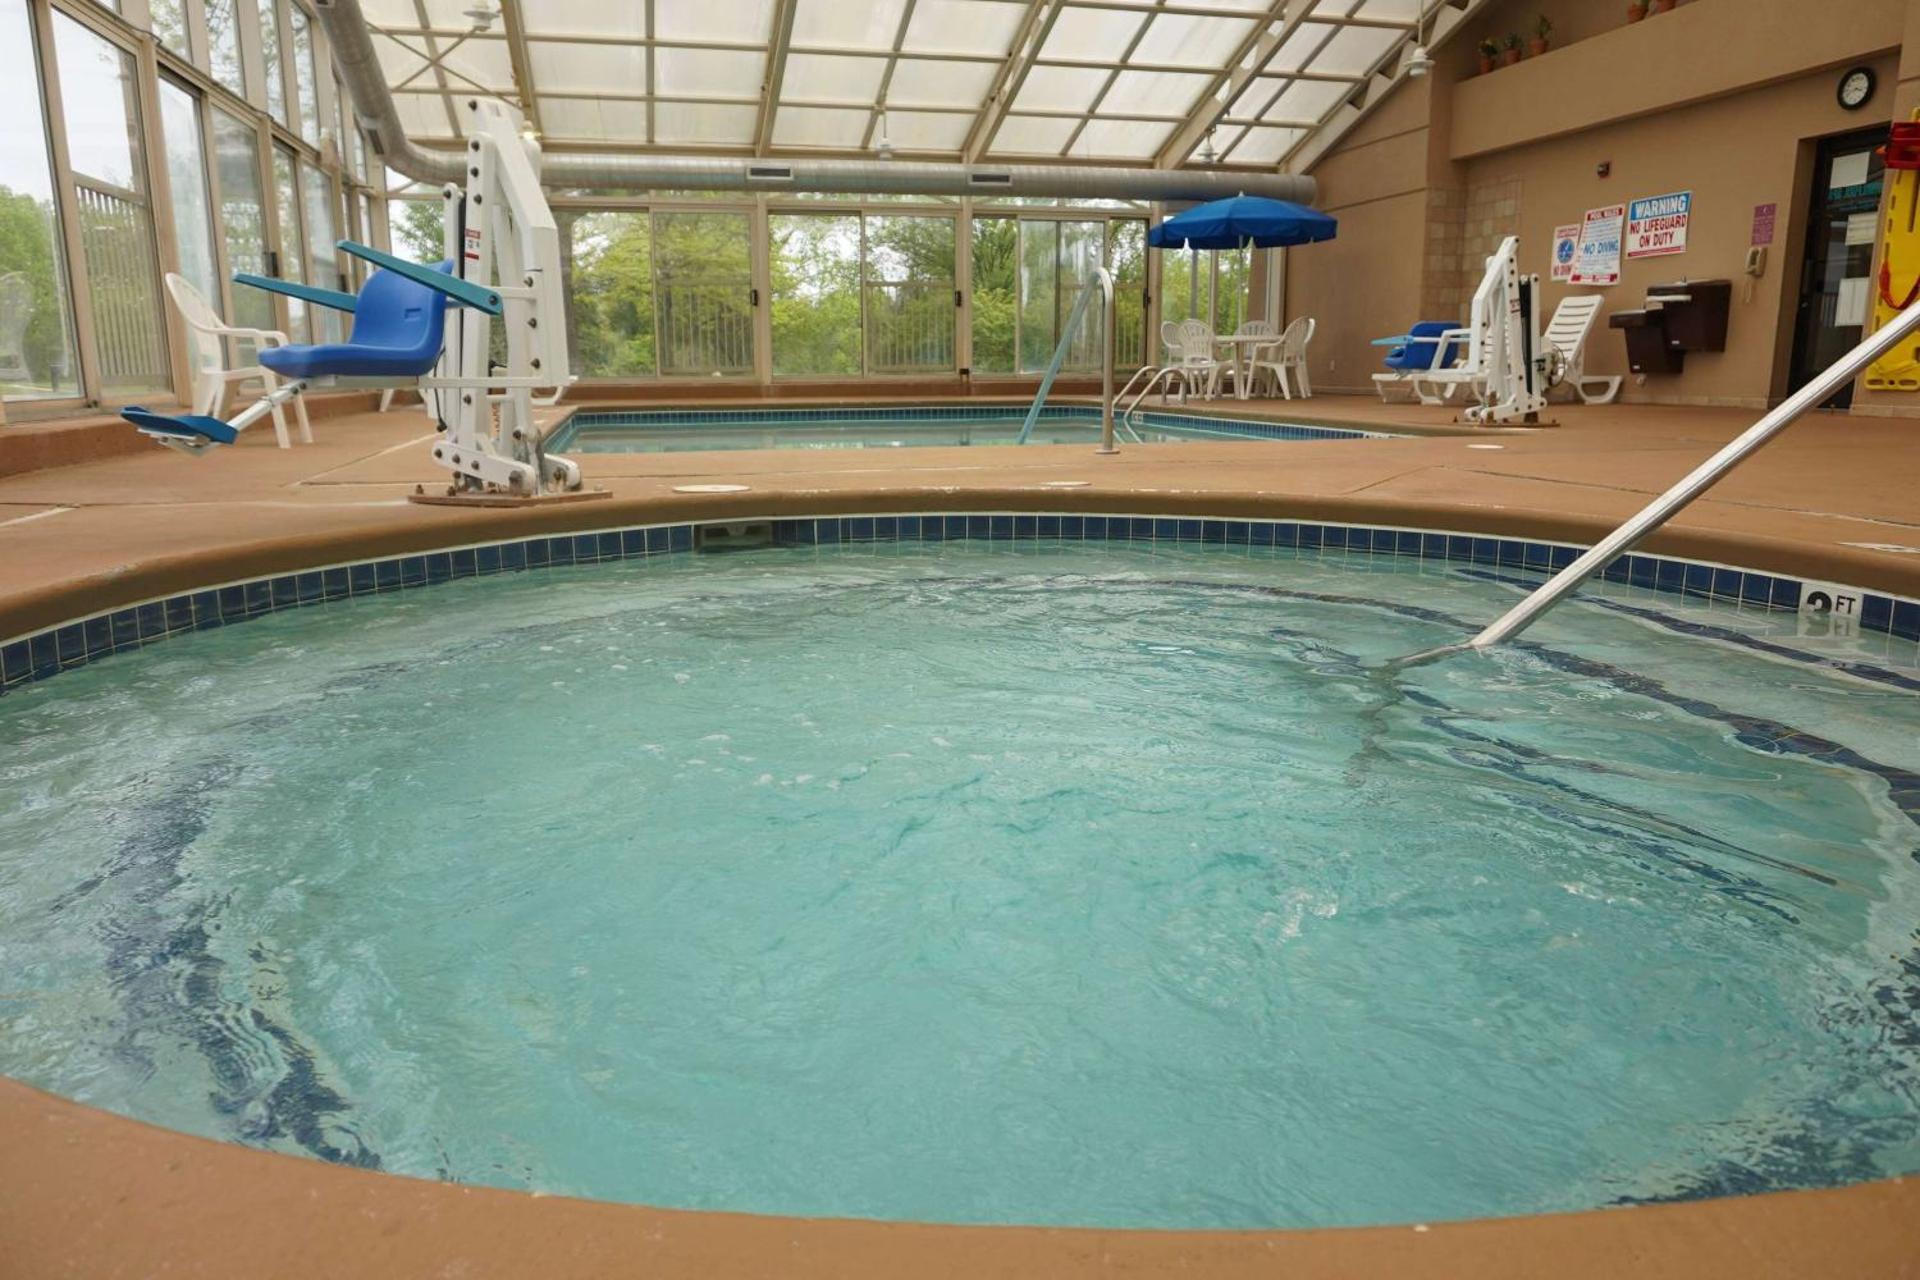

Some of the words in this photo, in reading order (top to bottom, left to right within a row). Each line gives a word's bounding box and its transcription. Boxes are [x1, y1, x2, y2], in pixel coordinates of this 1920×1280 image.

[1635, 195, 1687, 218] WARNING
[1630, 222, 1640, 234] NO
[1644, 214, 1687, 232] LIFEGUARD
[1583, 243, 1594, 256] NO
[1597, 240, 1619, 254] DIVING
[1639, 236, 1650, 247] ON
[1653, 232, 1675, 245] DUTY
[1835, 595, 1856, 614] FT
